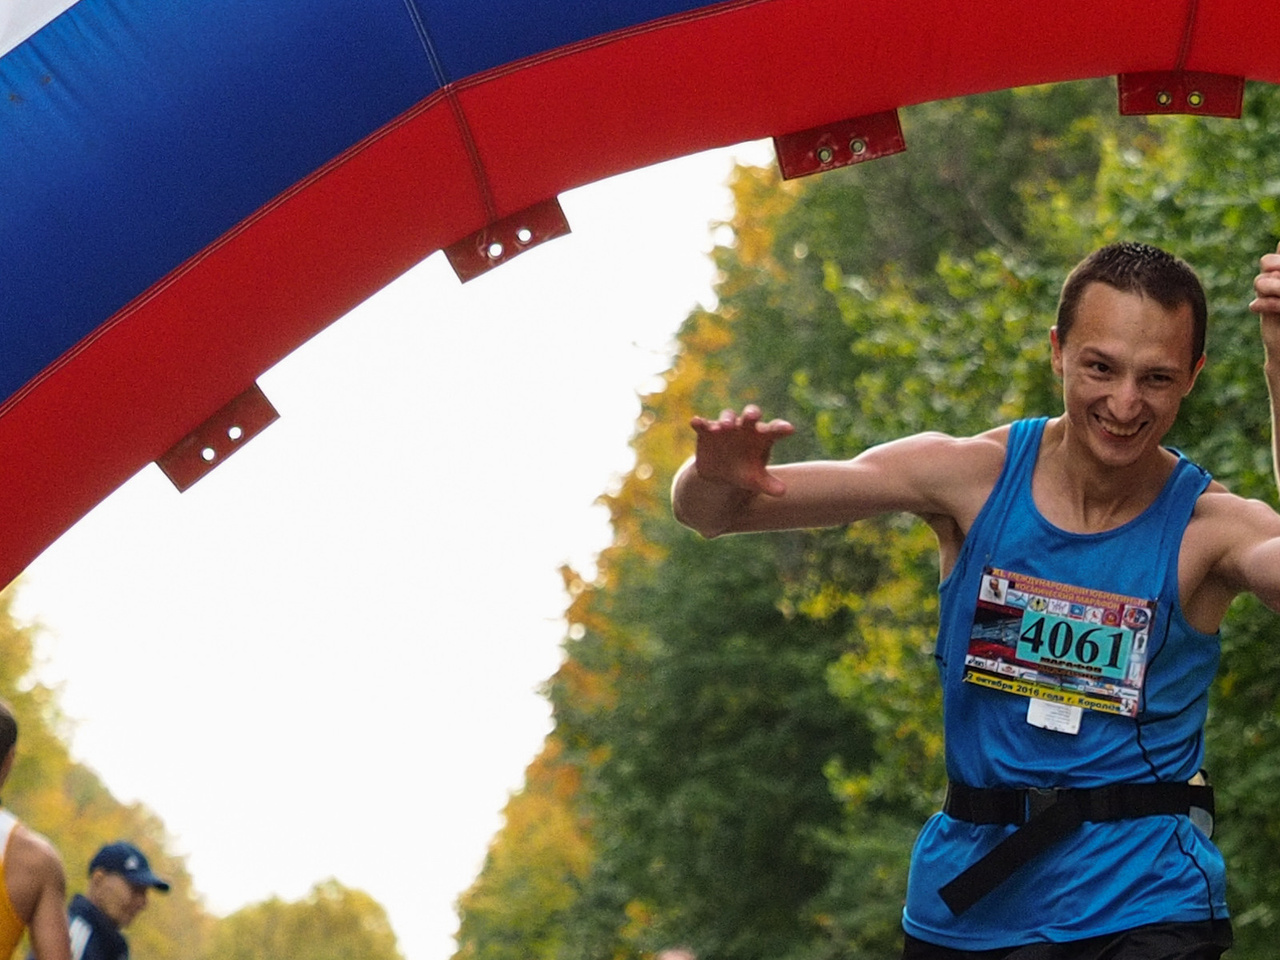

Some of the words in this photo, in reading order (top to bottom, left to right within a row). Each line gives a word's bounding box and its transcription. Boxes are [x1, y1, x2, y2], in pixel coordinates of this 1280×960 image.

[1020, 617, 1125, 669] 4061
[976, 676, 1013, 690] октября
[1017, 686, 1039, 696] 2016
[1042, 692, 1064, 702] года
